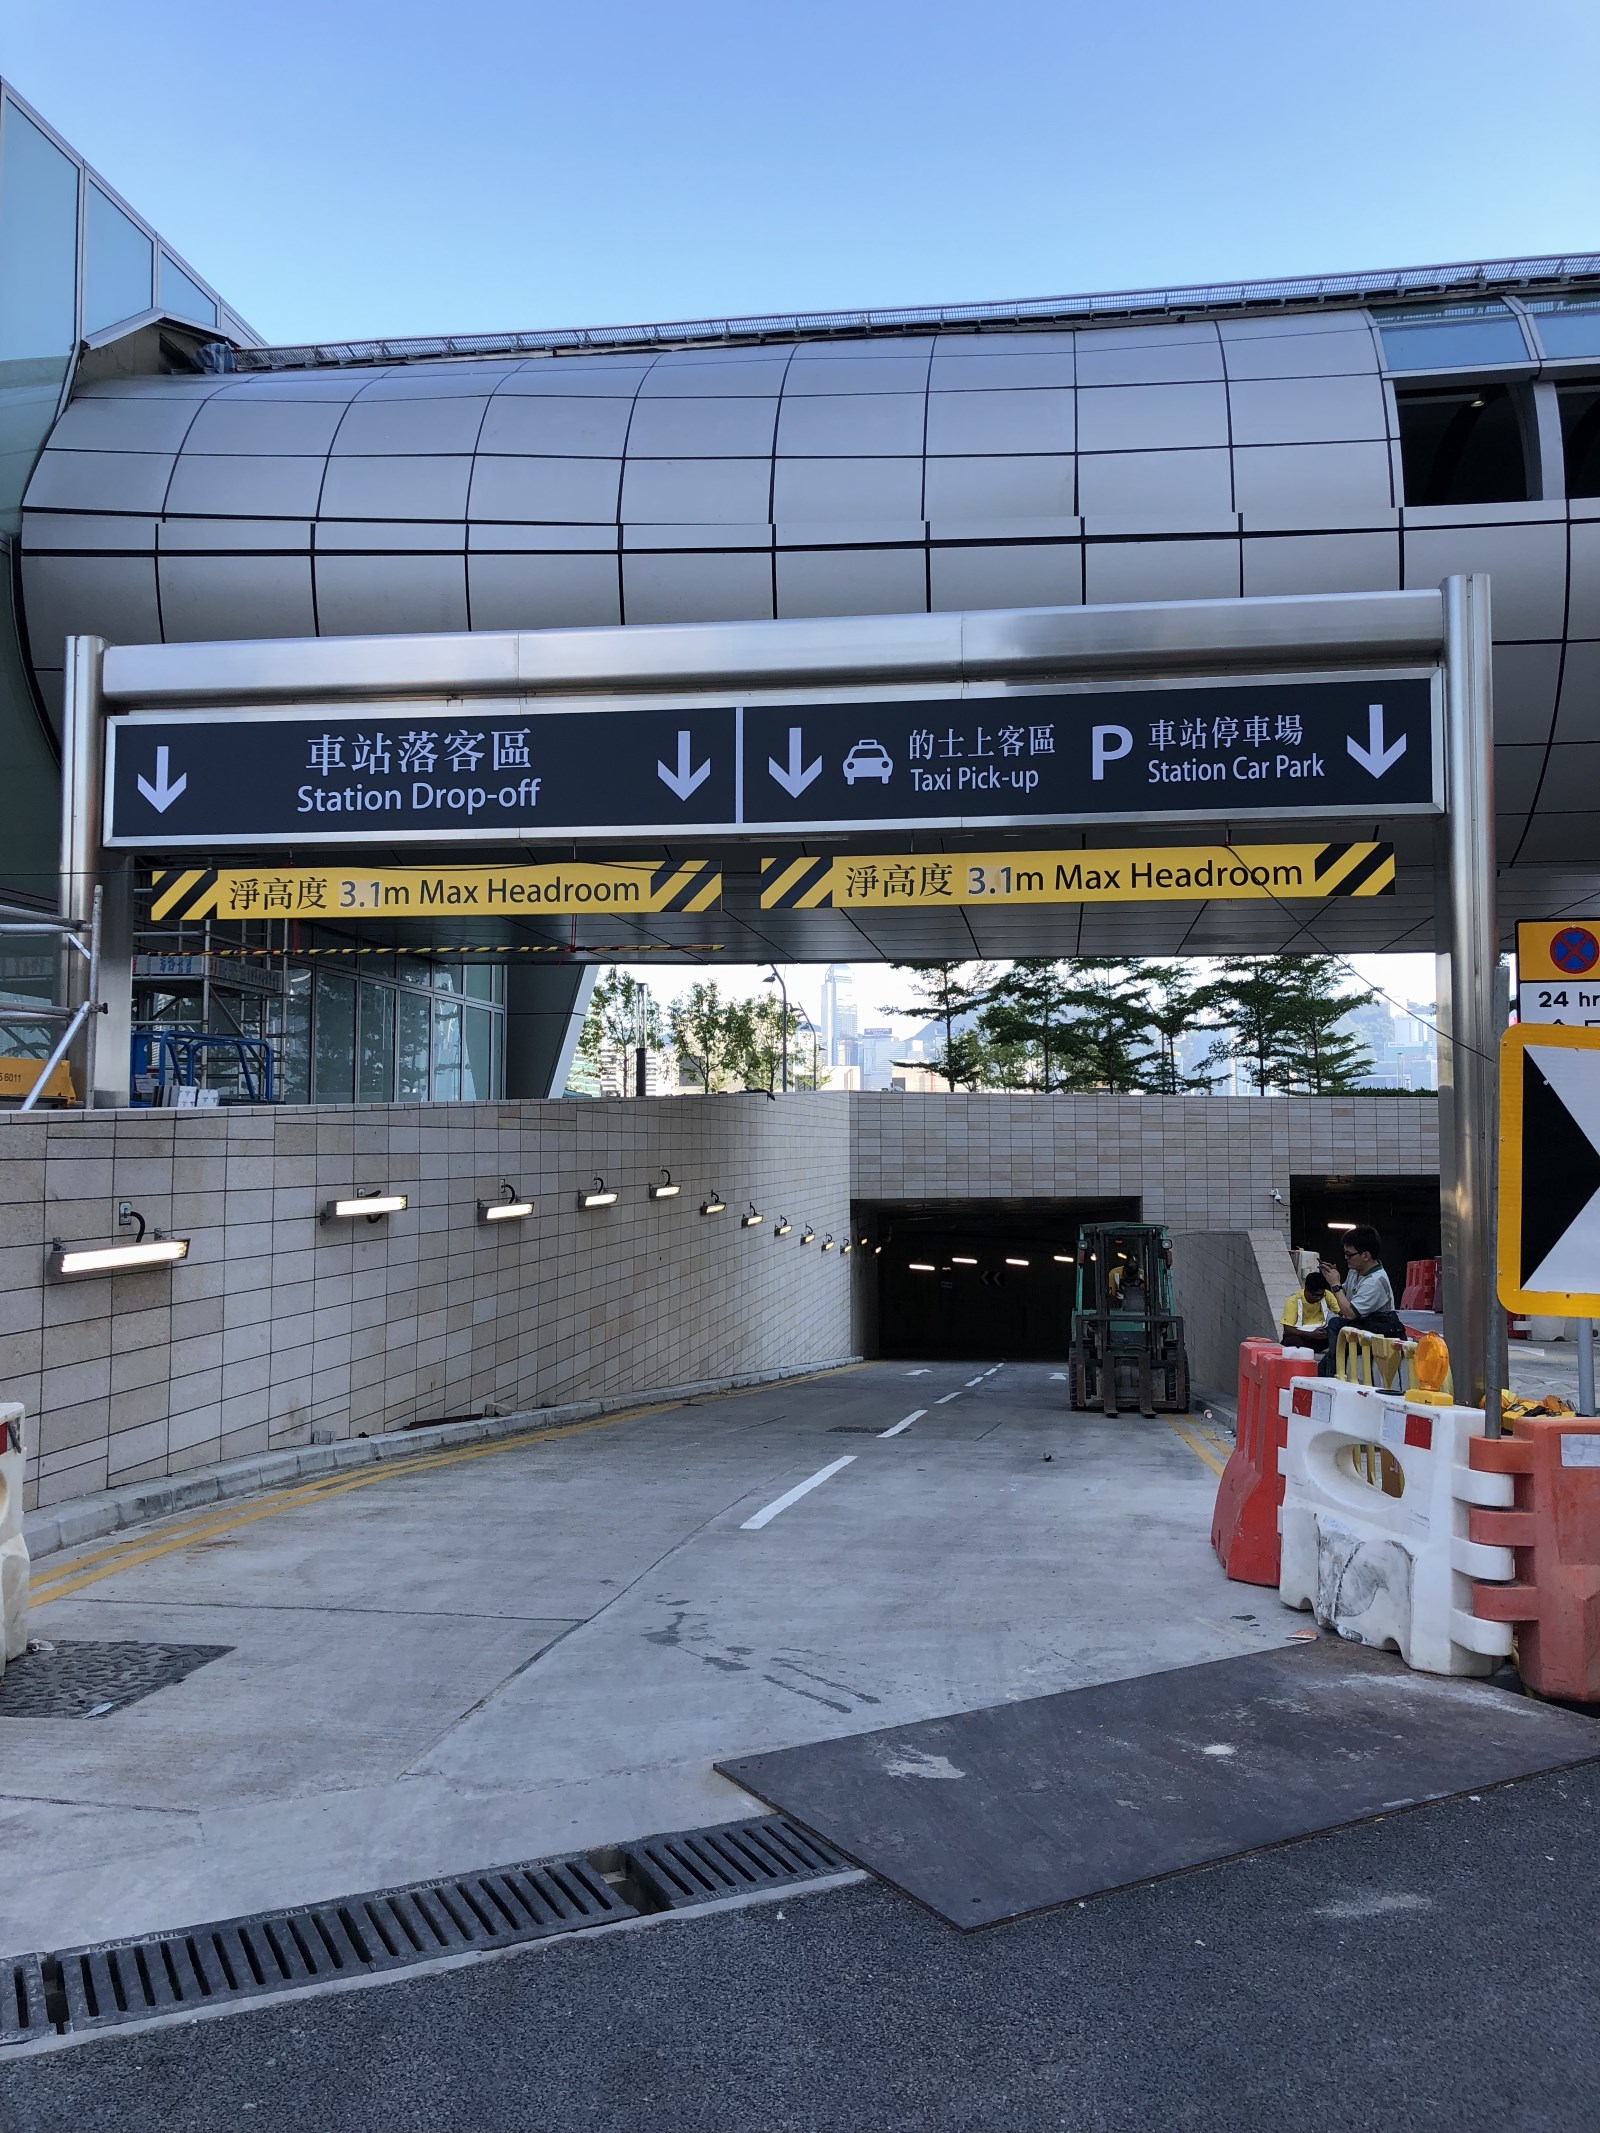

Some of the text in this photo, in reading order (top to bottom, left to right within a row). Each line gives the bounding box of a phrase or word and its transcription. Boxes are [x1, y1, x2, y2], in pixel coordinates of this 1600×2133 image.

[908, 723, 1057, 760] 的士上客區
[1148, 714, 1304, 752] 車站停車場
[304, 727, 532, 777] 車站落客區
[1092, 724, 1134, 781] P
[1148, 752, 1325, 783] Station Car Park
[297, 778, 542, 815] Station Drop-off
[910, 764, 1039, 794] Taxi Pick-up
[228, 875, 640, 911] 淨高度 3.1m Max Headroom
[845, 859, 1303, 898] 淨高度 3.1m Max Headroom
[1538, 990, 1569, 1008] 24
[4, 1072, 22, 1083] 6011
